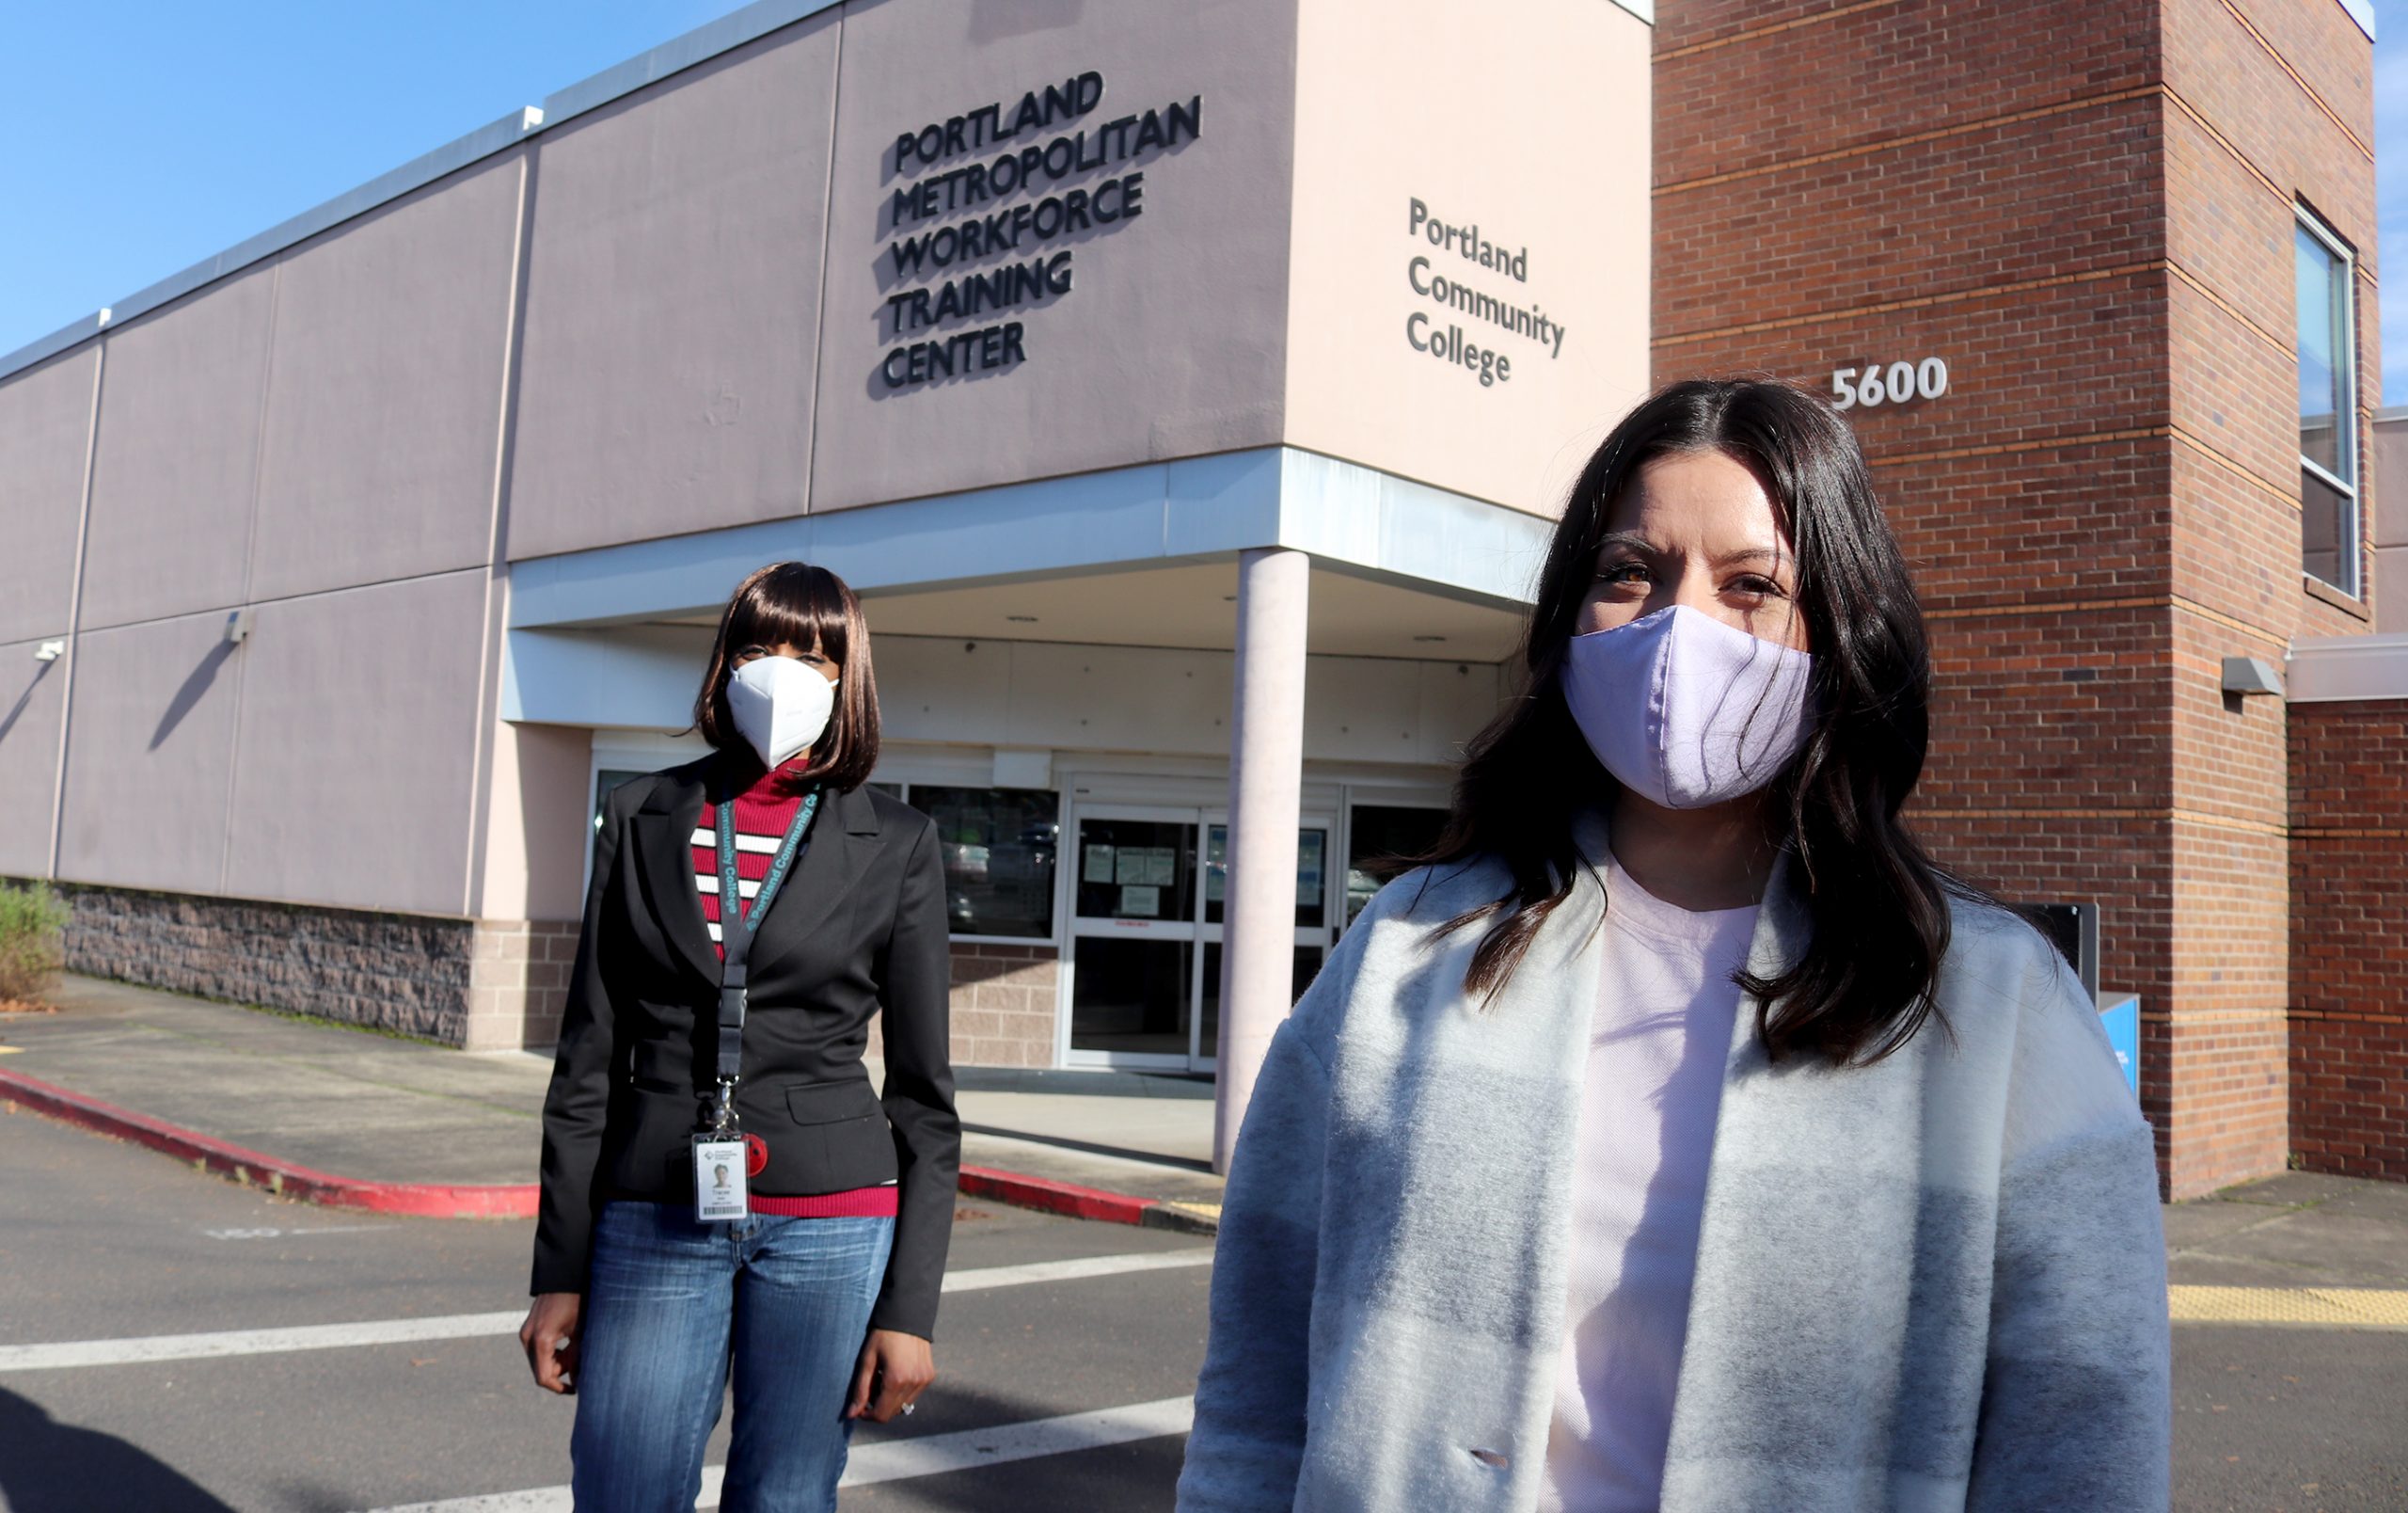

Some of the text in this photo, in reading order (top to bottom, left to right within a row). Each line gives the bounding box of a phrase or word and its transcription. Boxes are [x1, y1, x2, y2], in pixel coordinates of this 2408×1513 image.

[892, 95, 1203, 227] METROPOLITAN
[895, 71, 1105, 172] PORTLAND
[891, 172, 1144, 279] WORKFORCE
[1409, 196, 1527, 283] Portland
[888, 250, 1073, 333] TRAINING
[1408, 255, 1565, 359] Community
[882, 322, 1026, 389] CENTER
[1406, 311, 1511, 388] College
[1832, 357, 1947, 410] 5600
[725, 867, 738, 915] College
[751, 868, 782, 919] Portland
[775, 806, 813, 868] Community
